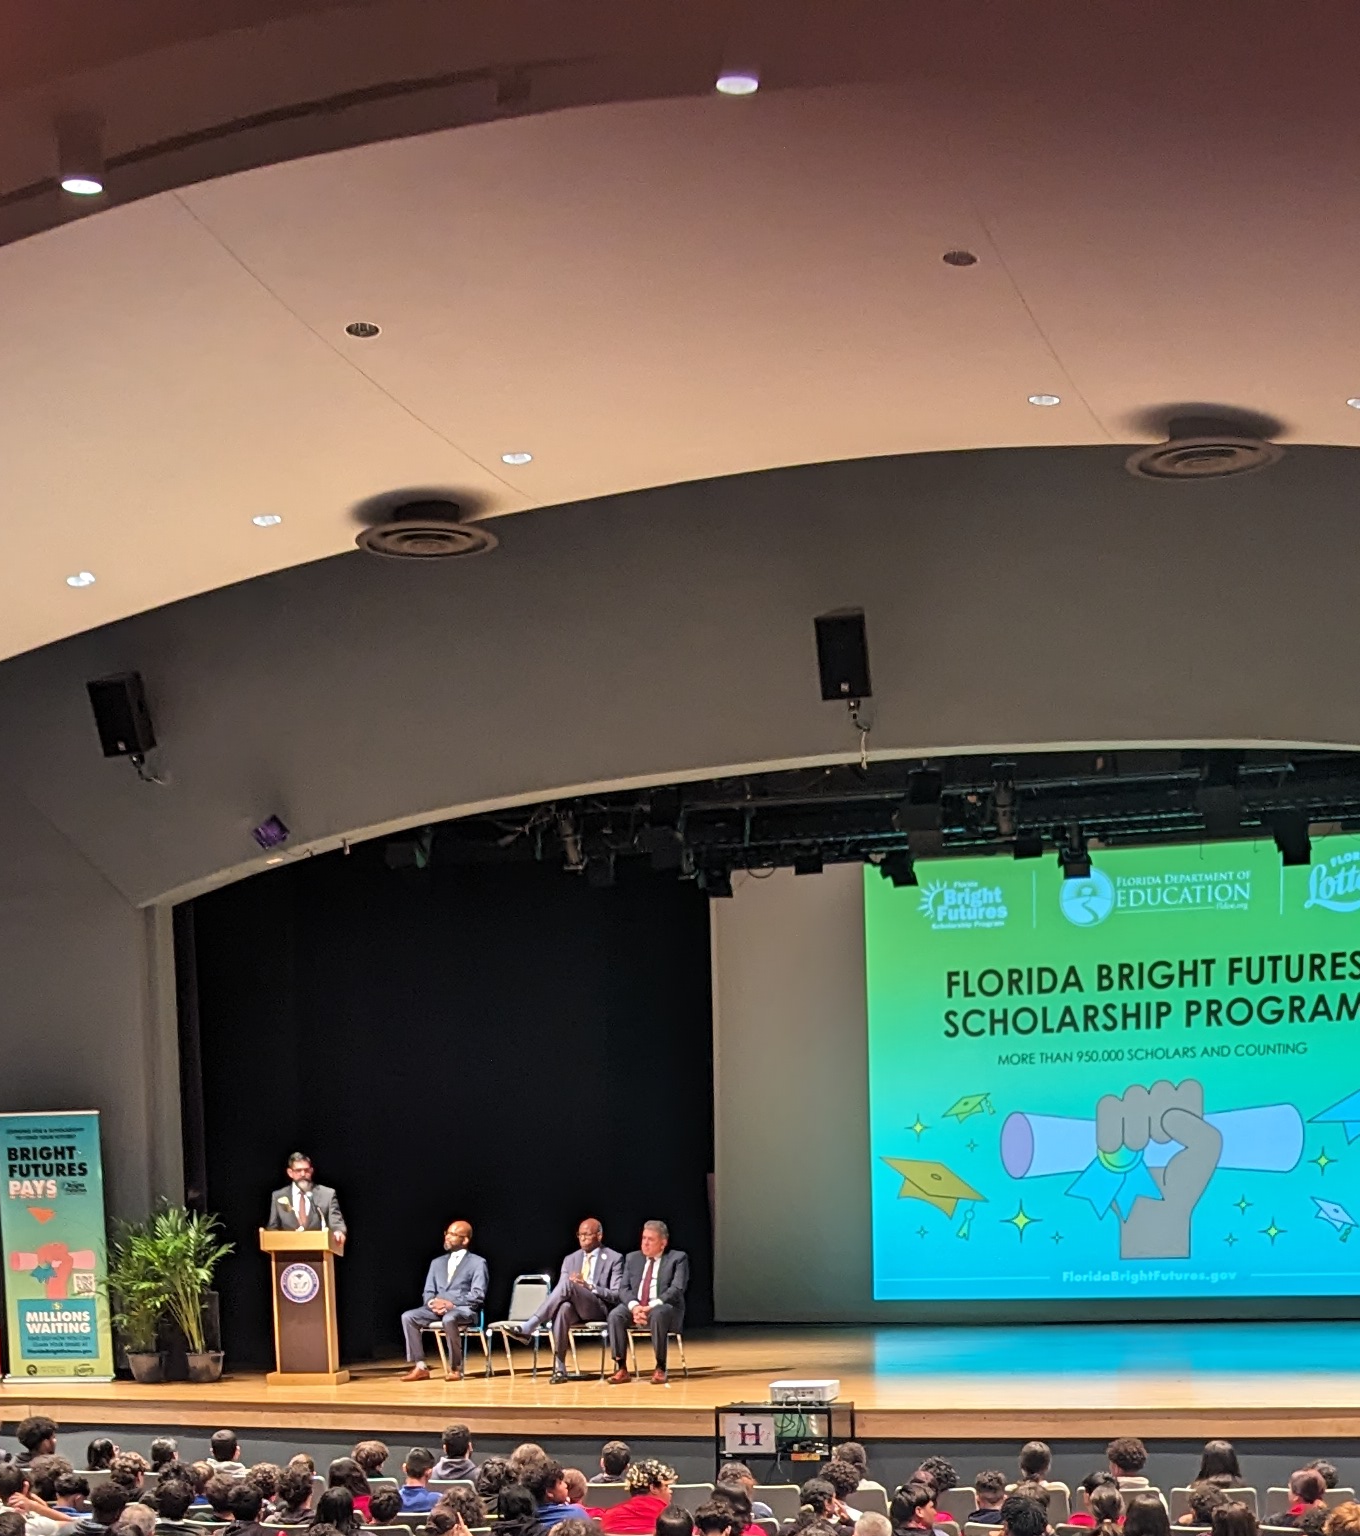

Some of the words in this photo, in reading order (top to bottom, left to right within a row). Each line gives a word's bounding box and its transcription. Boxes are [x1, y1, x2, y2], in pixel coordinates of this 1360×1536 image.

[943, 886, 1002, 907] Bright
[1116, 883, 1251, 908] EDUCATION
[937, 905, 1008, 922] Futures
[946, 965, 1084, 998] FLORIDA
[1096, 958, 1216, 992] BRIGHT
[943, 1000, 1172, 1038] SCHOLARSHIP
[998, 1053, 1036, 1066] MORE
[1039, 1051, 1073, 1064] THAN
[1076, 1049, 1125, 1064] 950,000
[1127, 1046, 1197, 1061] SCHOLARS
[1199, 1044, 1231, 1059] AND
[1233, 1041, 1308, 1057] COUNTING
[7, 1146, 76, 1161] BRIGHT
[8, 1162, 88, 1178] FUTURES
[8, 1179, 57, 1198] PAYS
[1062, 1270, 1237, 1284] FloridaBrightFutures.gov
[26, 1311, 91, 1322] MILLIONS
[26, 1322, 91, 1334] WAITING
[738, 1423, 762, 1446] H
